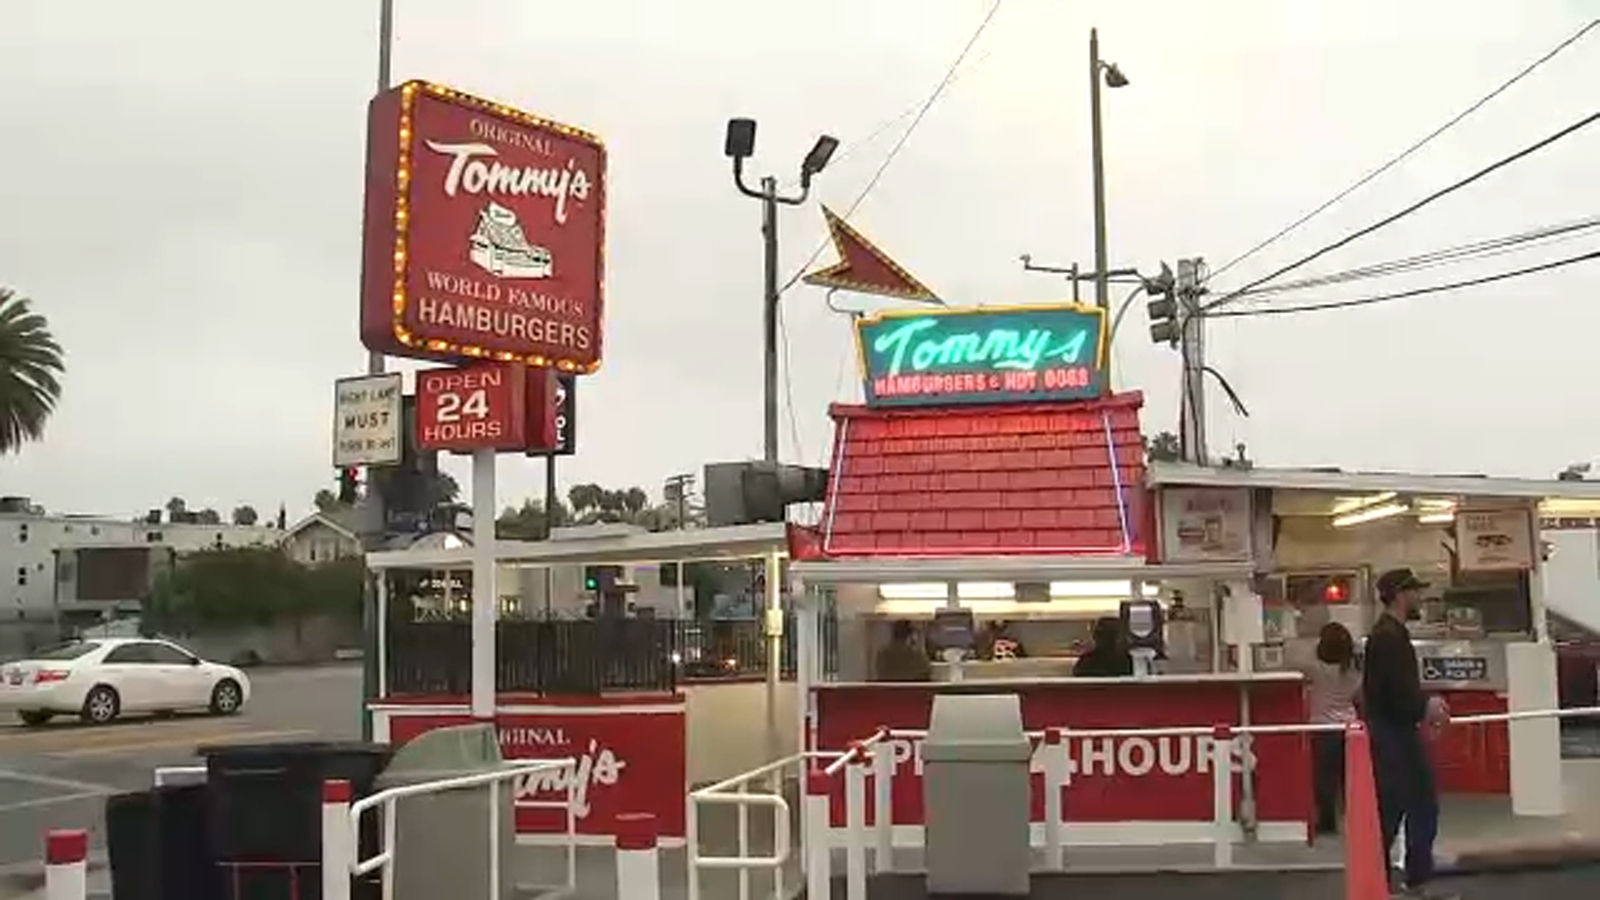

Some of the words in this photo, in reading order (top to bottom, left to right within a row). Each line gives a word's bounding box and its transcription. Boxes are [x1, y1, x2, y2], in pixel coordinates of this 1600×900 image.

[469, 118, 554, 157] ORIGINAL
[425, 138, 592, 224] Tommy's
[427, 271, 501, 299] WORLD
[508, 288, 584, 317] FAMOUS
[418, 297, 591, 349] HAMBURGERS
[426, 369, 502, 393] OPEN
[874, 371, 986, 396] HAMBURGERS
[1004, 371, 1036, 391] HOT
[344, 411, 390, 429] MUST
[436, 389, 489, 423] 24
[423, 420, 502, 441] HOURS
